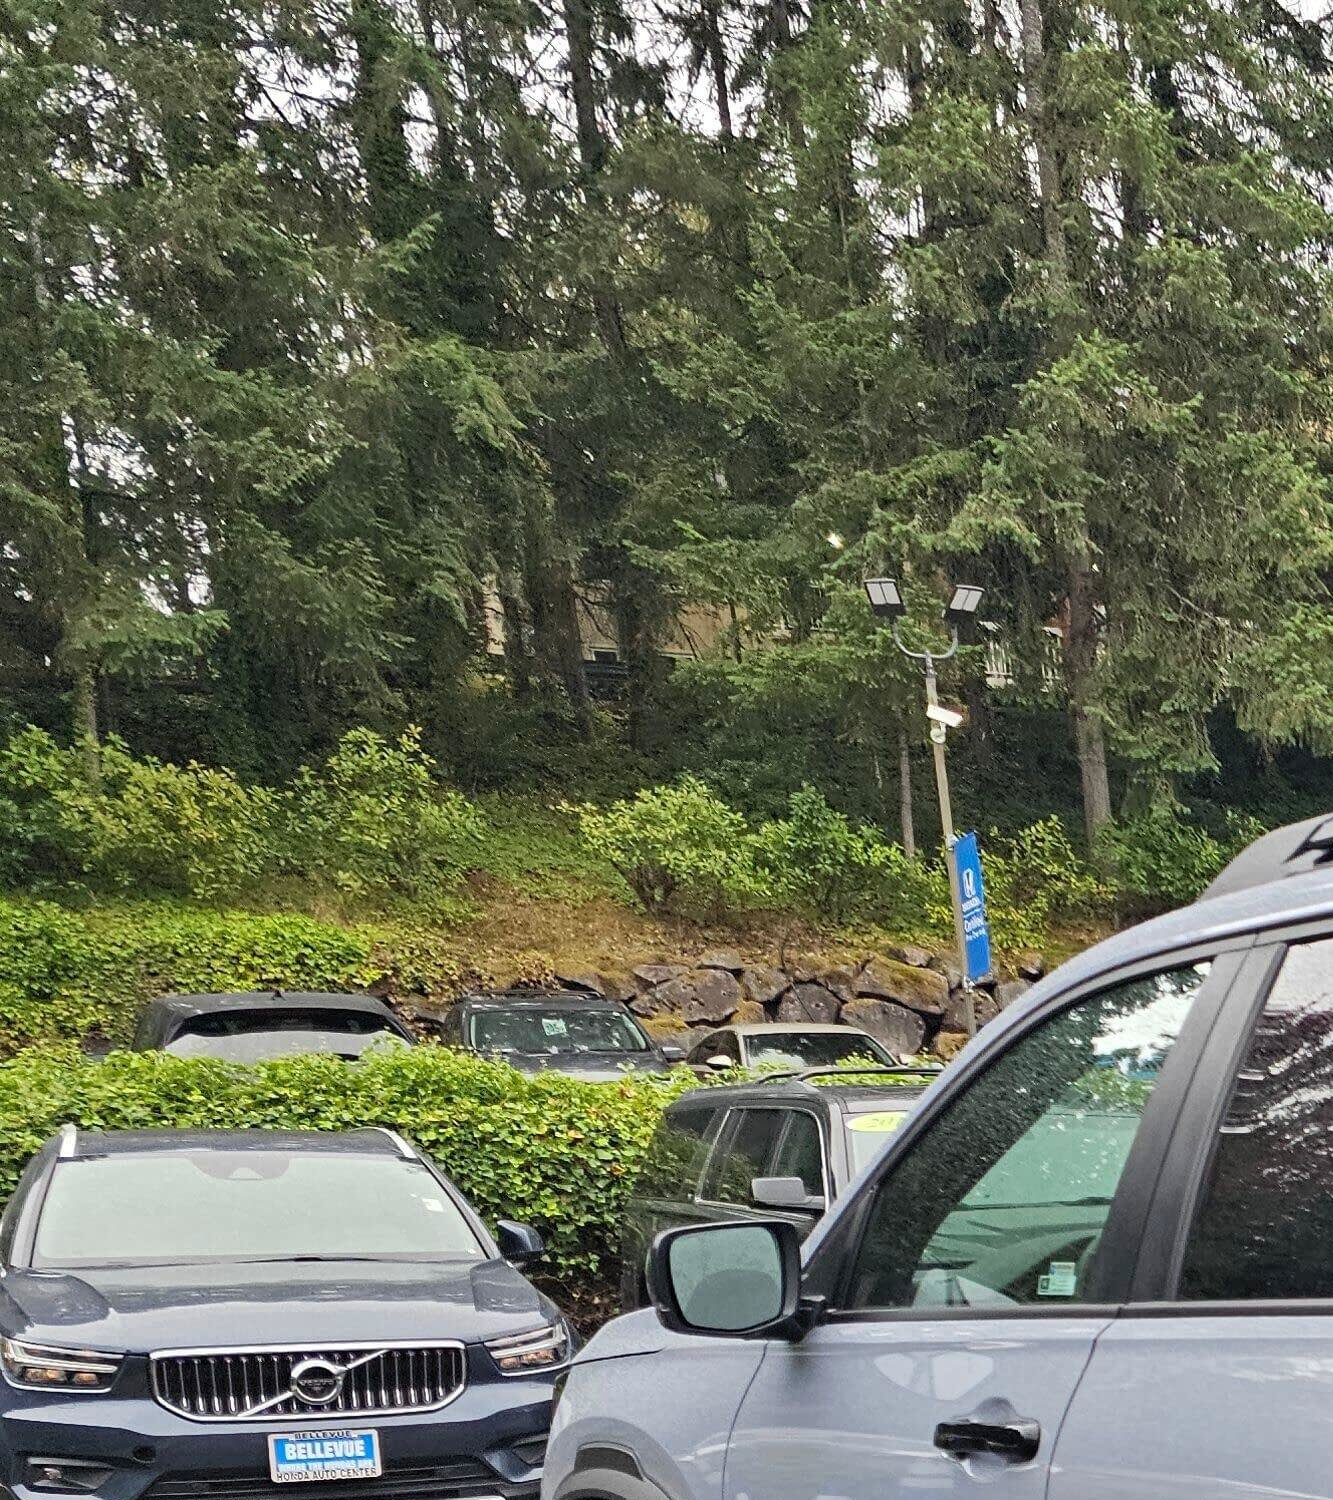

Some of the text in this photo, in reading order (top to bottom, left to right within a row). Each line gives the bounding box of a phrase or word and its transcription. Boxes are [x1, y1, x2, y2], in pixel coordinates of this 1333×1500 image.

[294, 1431, 352, 1440] BELLEVUE
[284, 1440, 366, 1461] BELLEVUE
[276, 1467, 377, 1481] HONDA AUTO CENTER
